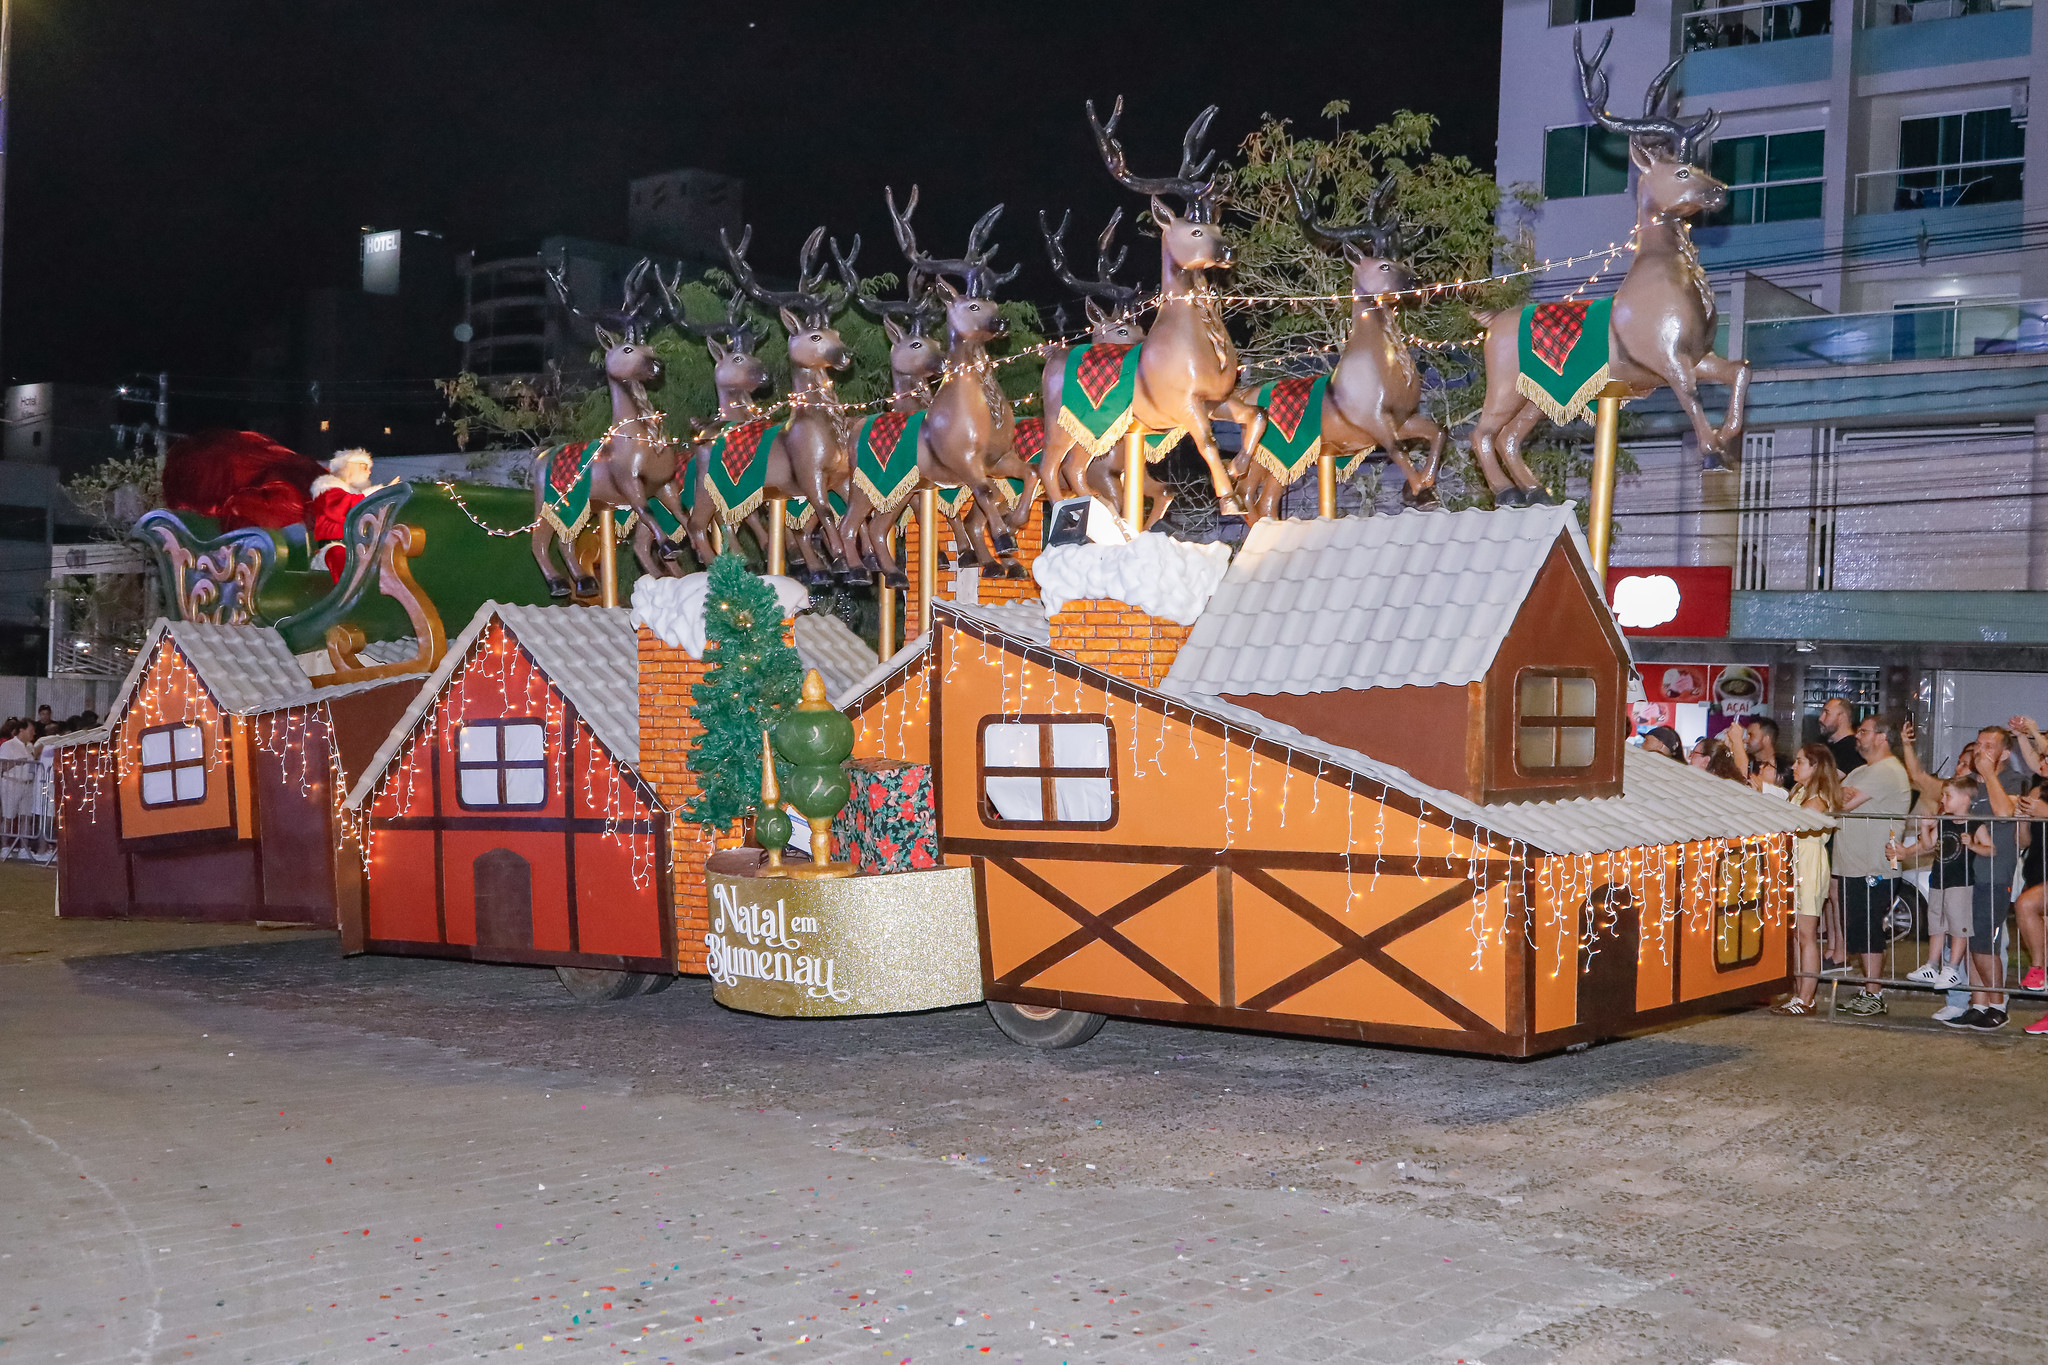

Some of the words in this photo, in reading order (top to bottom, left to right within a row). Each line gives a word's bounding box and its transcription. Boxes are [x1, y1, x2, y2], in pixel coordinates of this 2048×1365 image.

[366, 234, 397, 254] HOTEL
[713, 883, 801, 950] Natal
[790, 916, 818, 933] em
